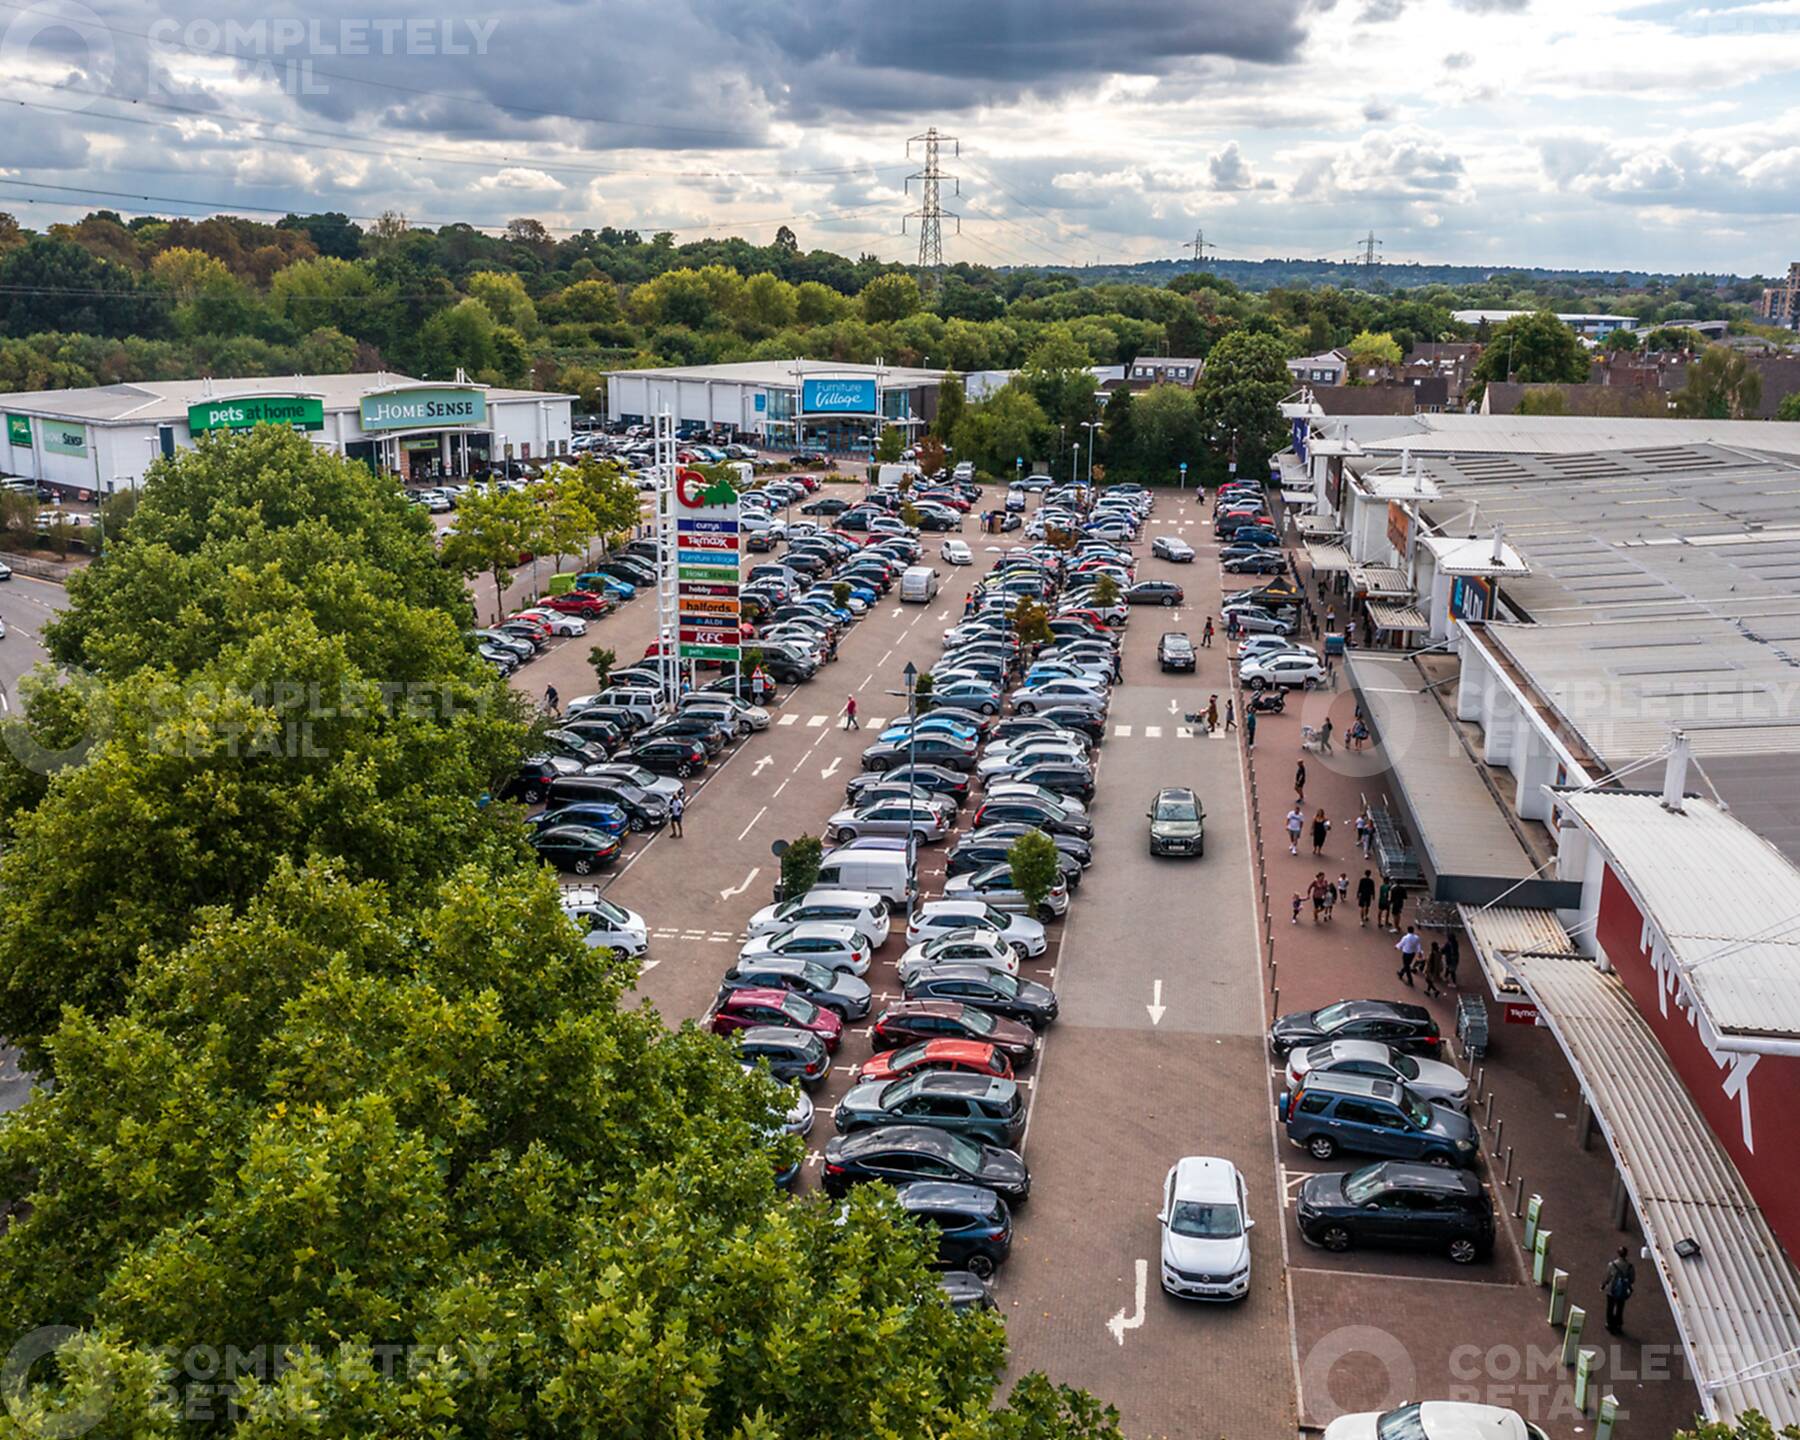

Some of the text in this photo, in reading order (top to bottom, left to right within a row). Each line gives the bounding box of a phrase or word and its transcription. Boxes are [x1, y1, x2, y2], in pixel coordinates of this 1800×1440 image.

[816, 382, 862, 393] Furniture
[816, 392, 863, 408] Village
[209, 403, 305, 425] pets at home
[695, 523, 720, 532] currys
[681, 553, 736, 564] Furniture Village
[688, 585, 729, 595] hobbycraft
[686, 602, 732, 613] halfords
[1462, 584, 1484, 621] ALDI
[704, 618, 724, 626] ALDI
[695, 632, 724, 644] KFC
[688, 648, 704, 656] pets
